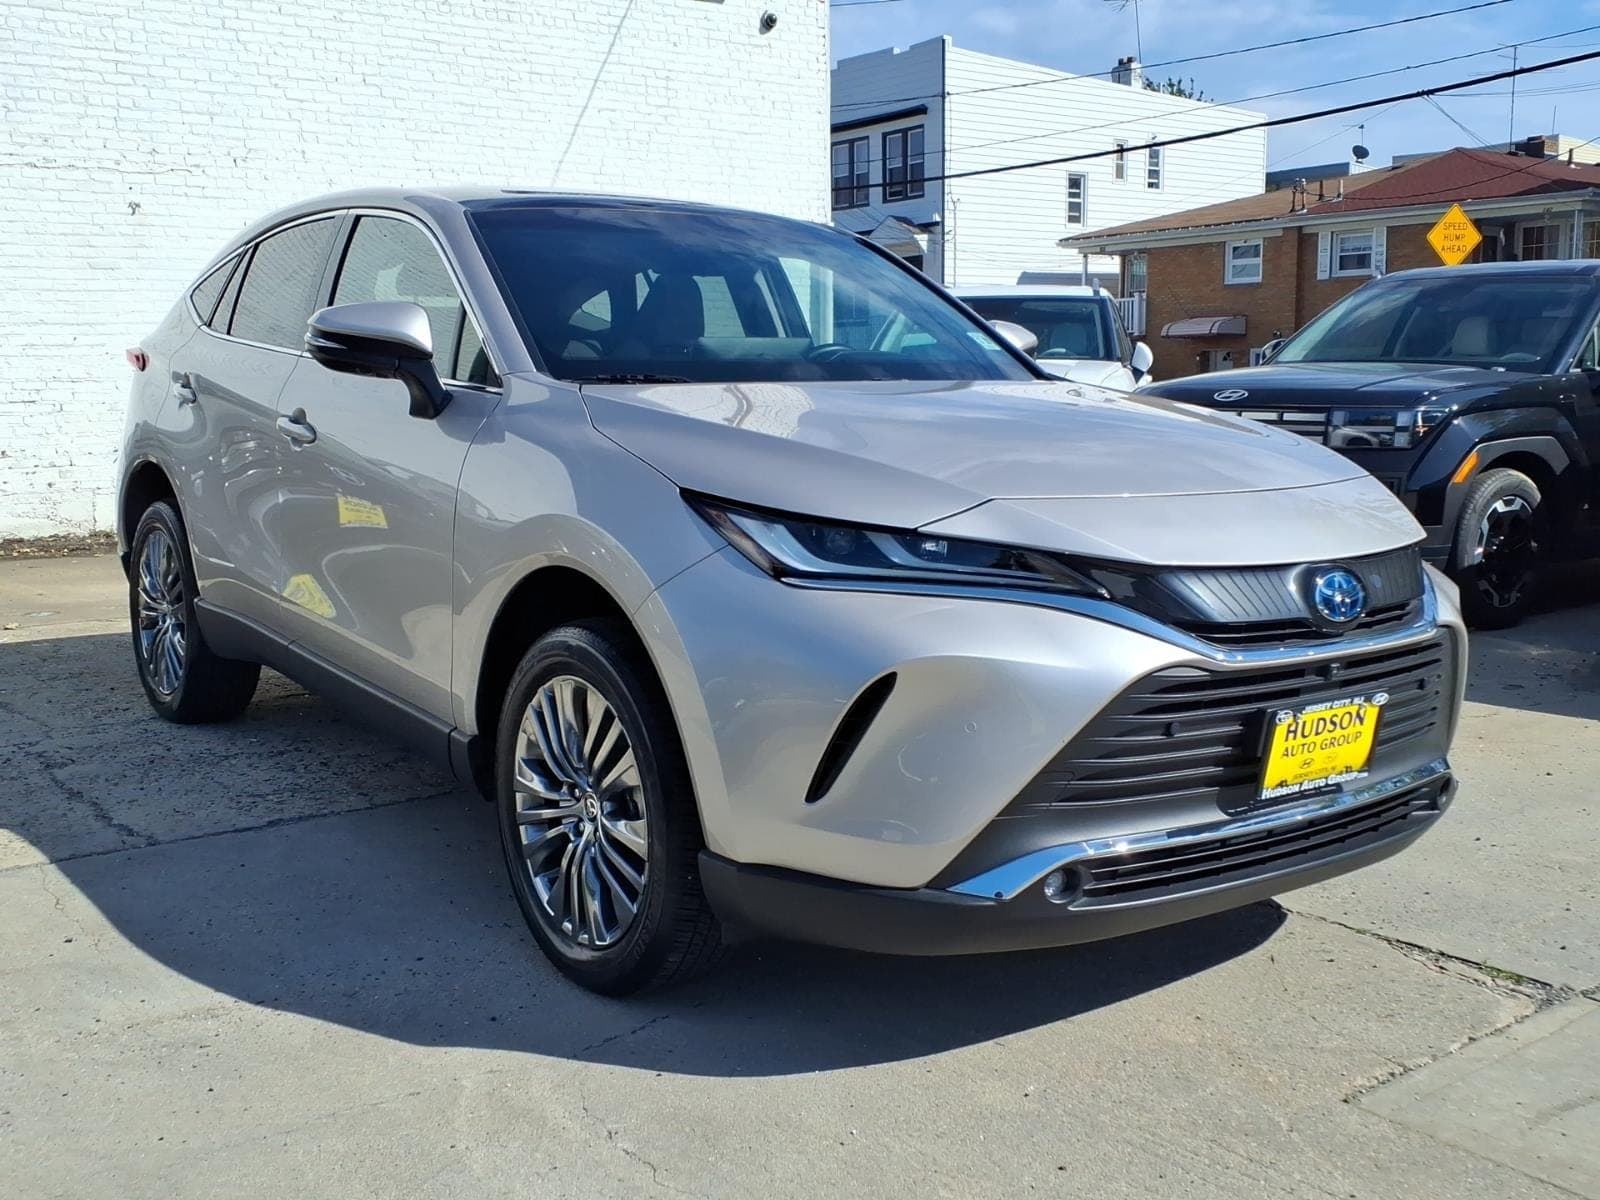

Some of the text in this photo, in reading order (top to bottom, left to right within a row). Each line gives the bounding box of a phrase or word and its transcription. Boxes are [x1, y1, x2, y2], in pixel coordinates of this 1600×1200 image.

[1443, 222, 1467, 230] SPEED
[1443, 233, 1466, 241] HUMP
[1441, 244, 1467, 254] AHEAD
[1284, 711, 1366, 742] HUDSON
[1282, 731, 1362, 758] AUTO GROUP
